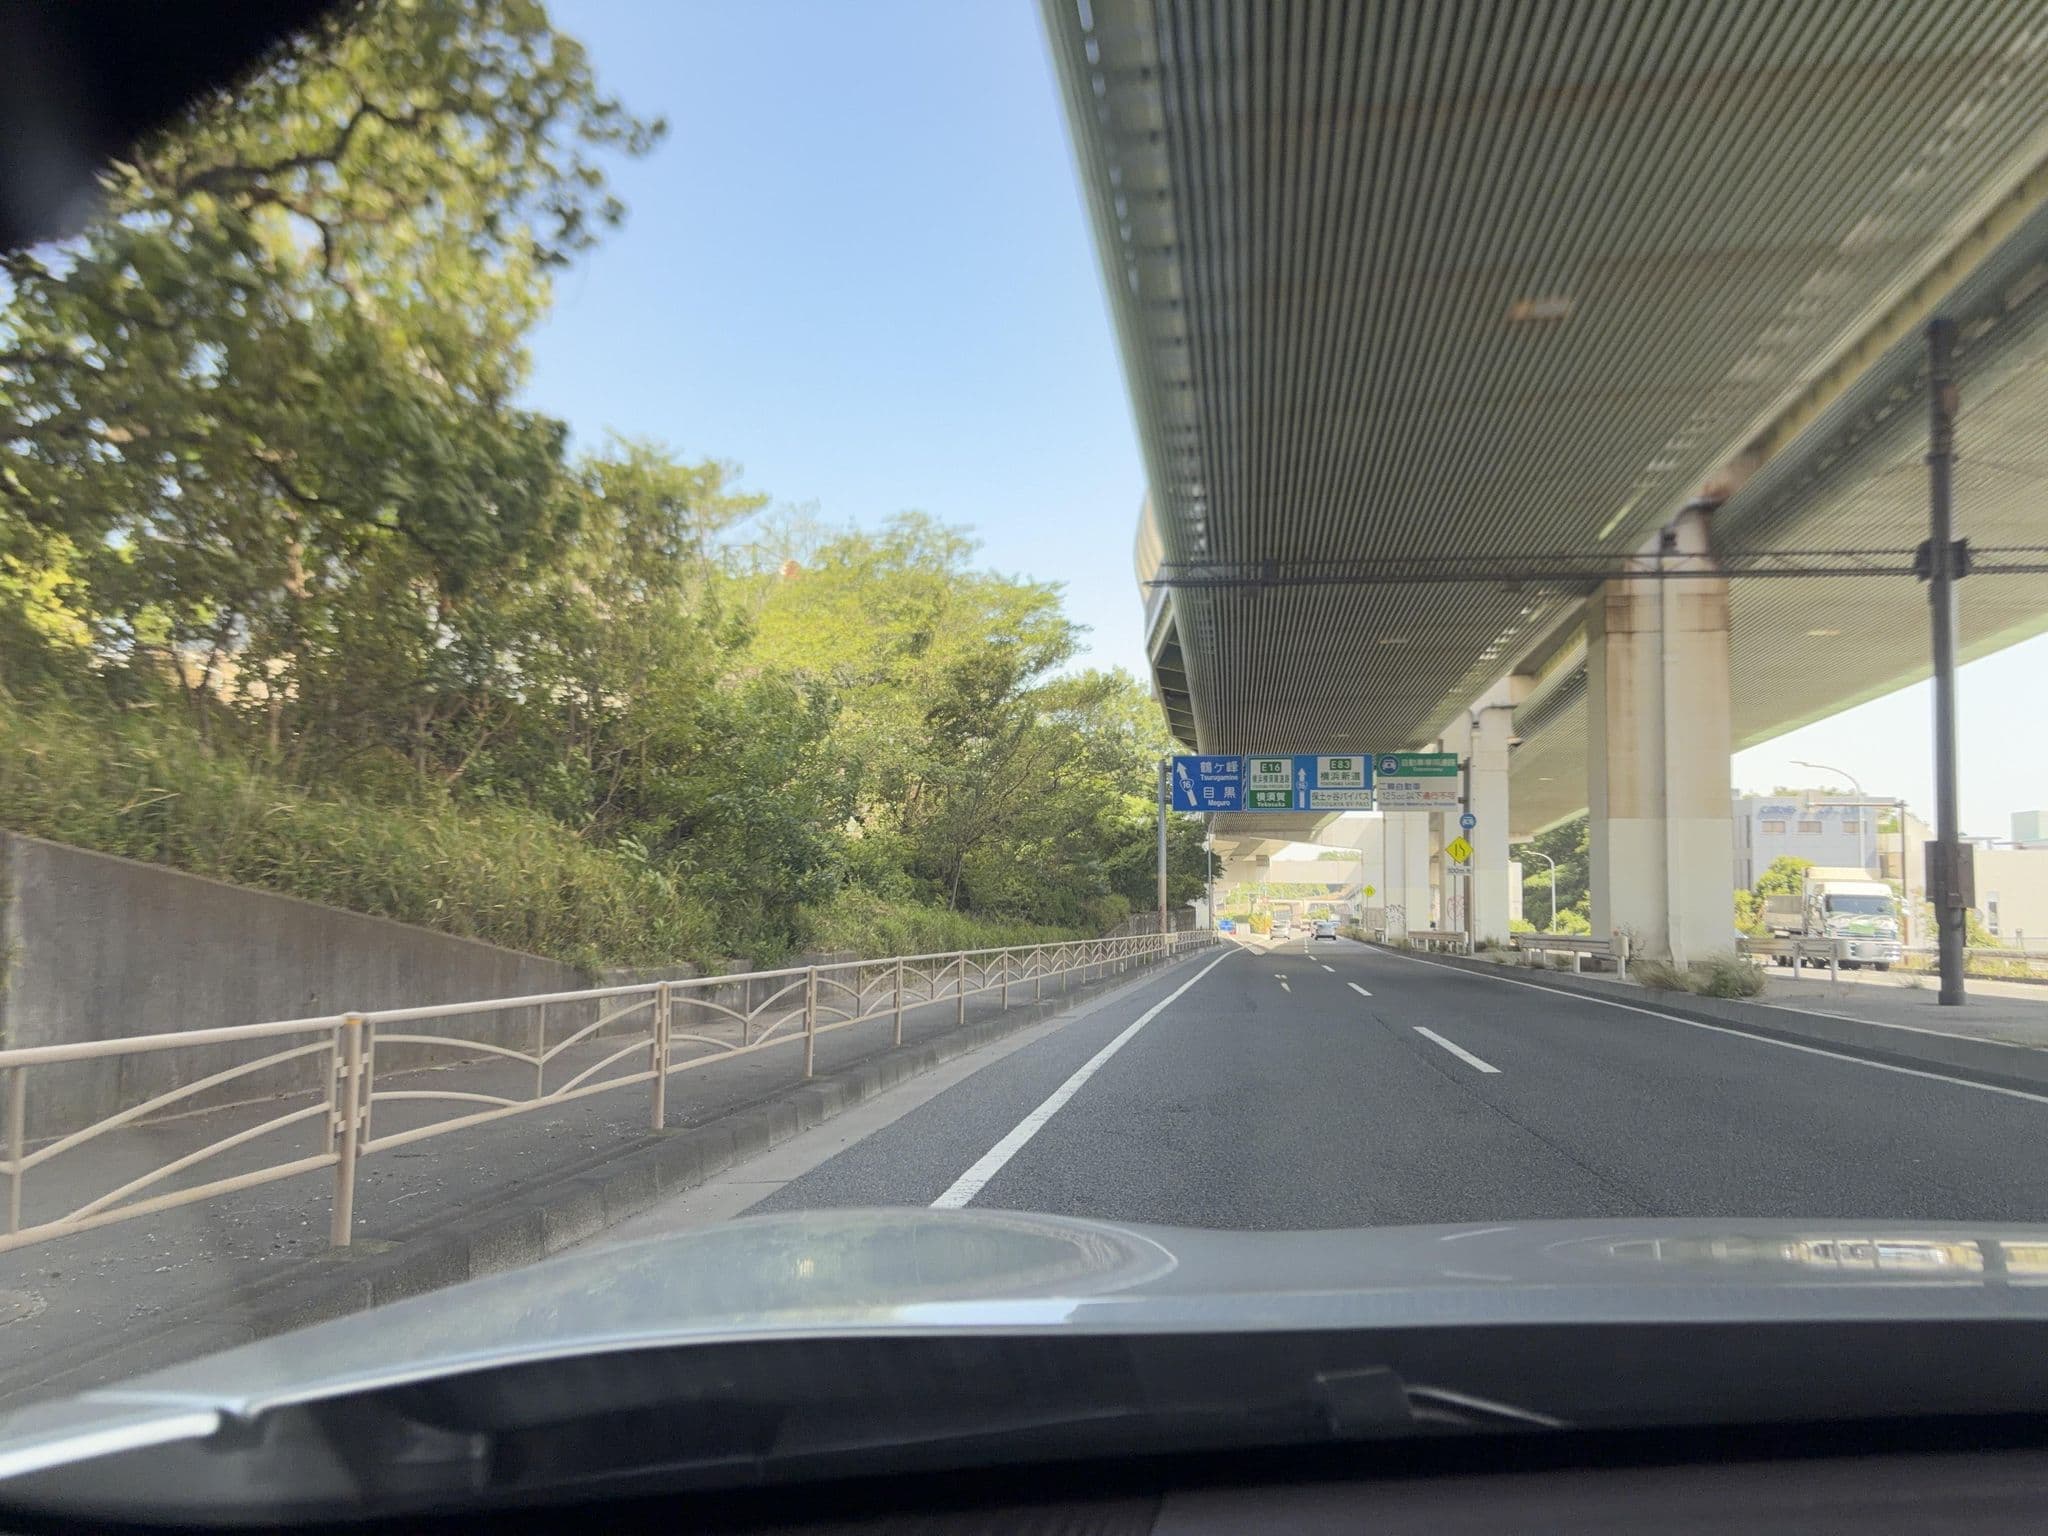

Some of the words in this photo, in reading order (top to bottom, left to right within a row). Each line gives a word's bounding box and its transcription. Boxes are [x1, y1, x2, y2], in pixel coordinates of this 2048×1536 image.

[1261, 763, 1281, 772] E16
[1331, 760, 1350, 769] E83
[1320, 772, 1361, 781] 横浜新道
[1182, 781, 1191, 789] 16
[1208, 799, 1231, 807] Meguro
